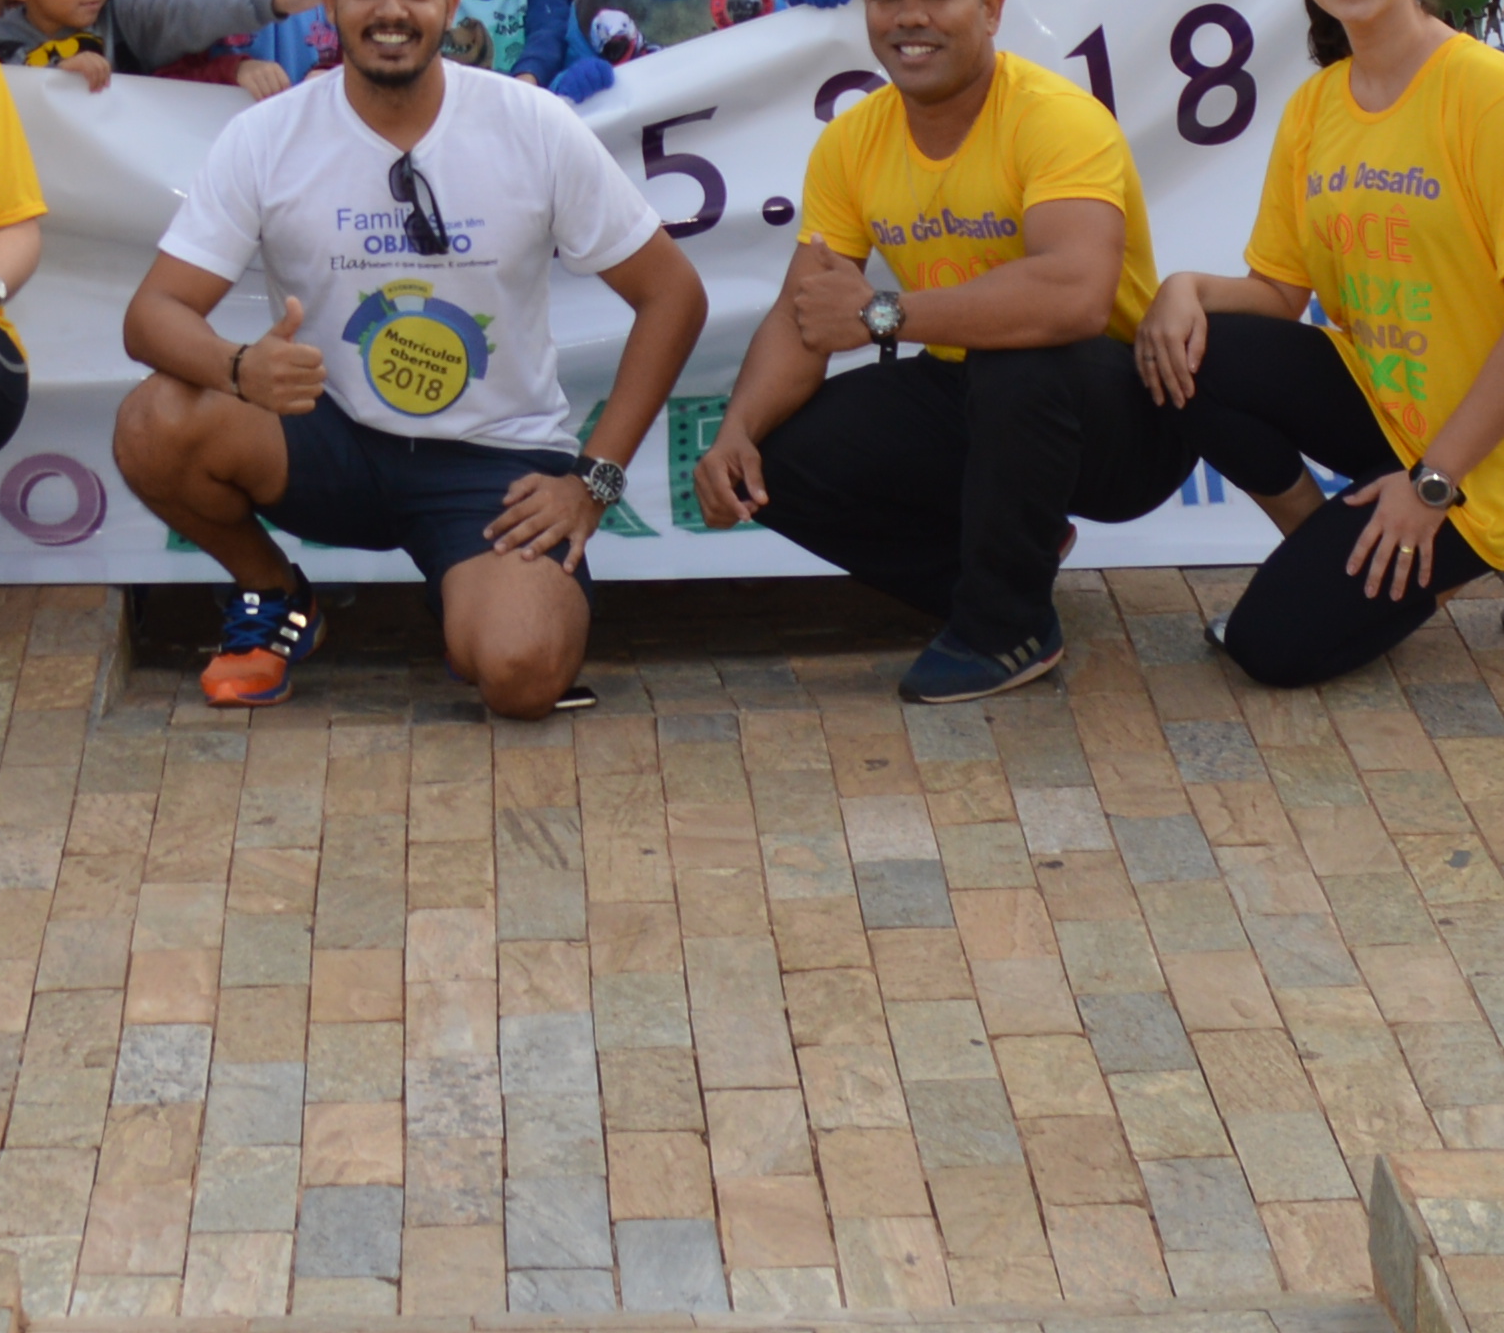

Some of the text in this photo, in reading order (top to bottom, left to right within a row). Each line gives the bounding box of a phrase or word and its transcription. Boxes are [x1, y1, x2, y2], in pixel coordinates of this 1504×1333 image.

[1353, 162, 1441, 200] Desafio
[871, 218, 906, 245] Dia
[1312, 203, 1414, 263] VOCÊ
[384, 328, 463, 365] Matrículas
[390, 345, 448, 376] abertas
[378, 358, 444, 402] 2018
